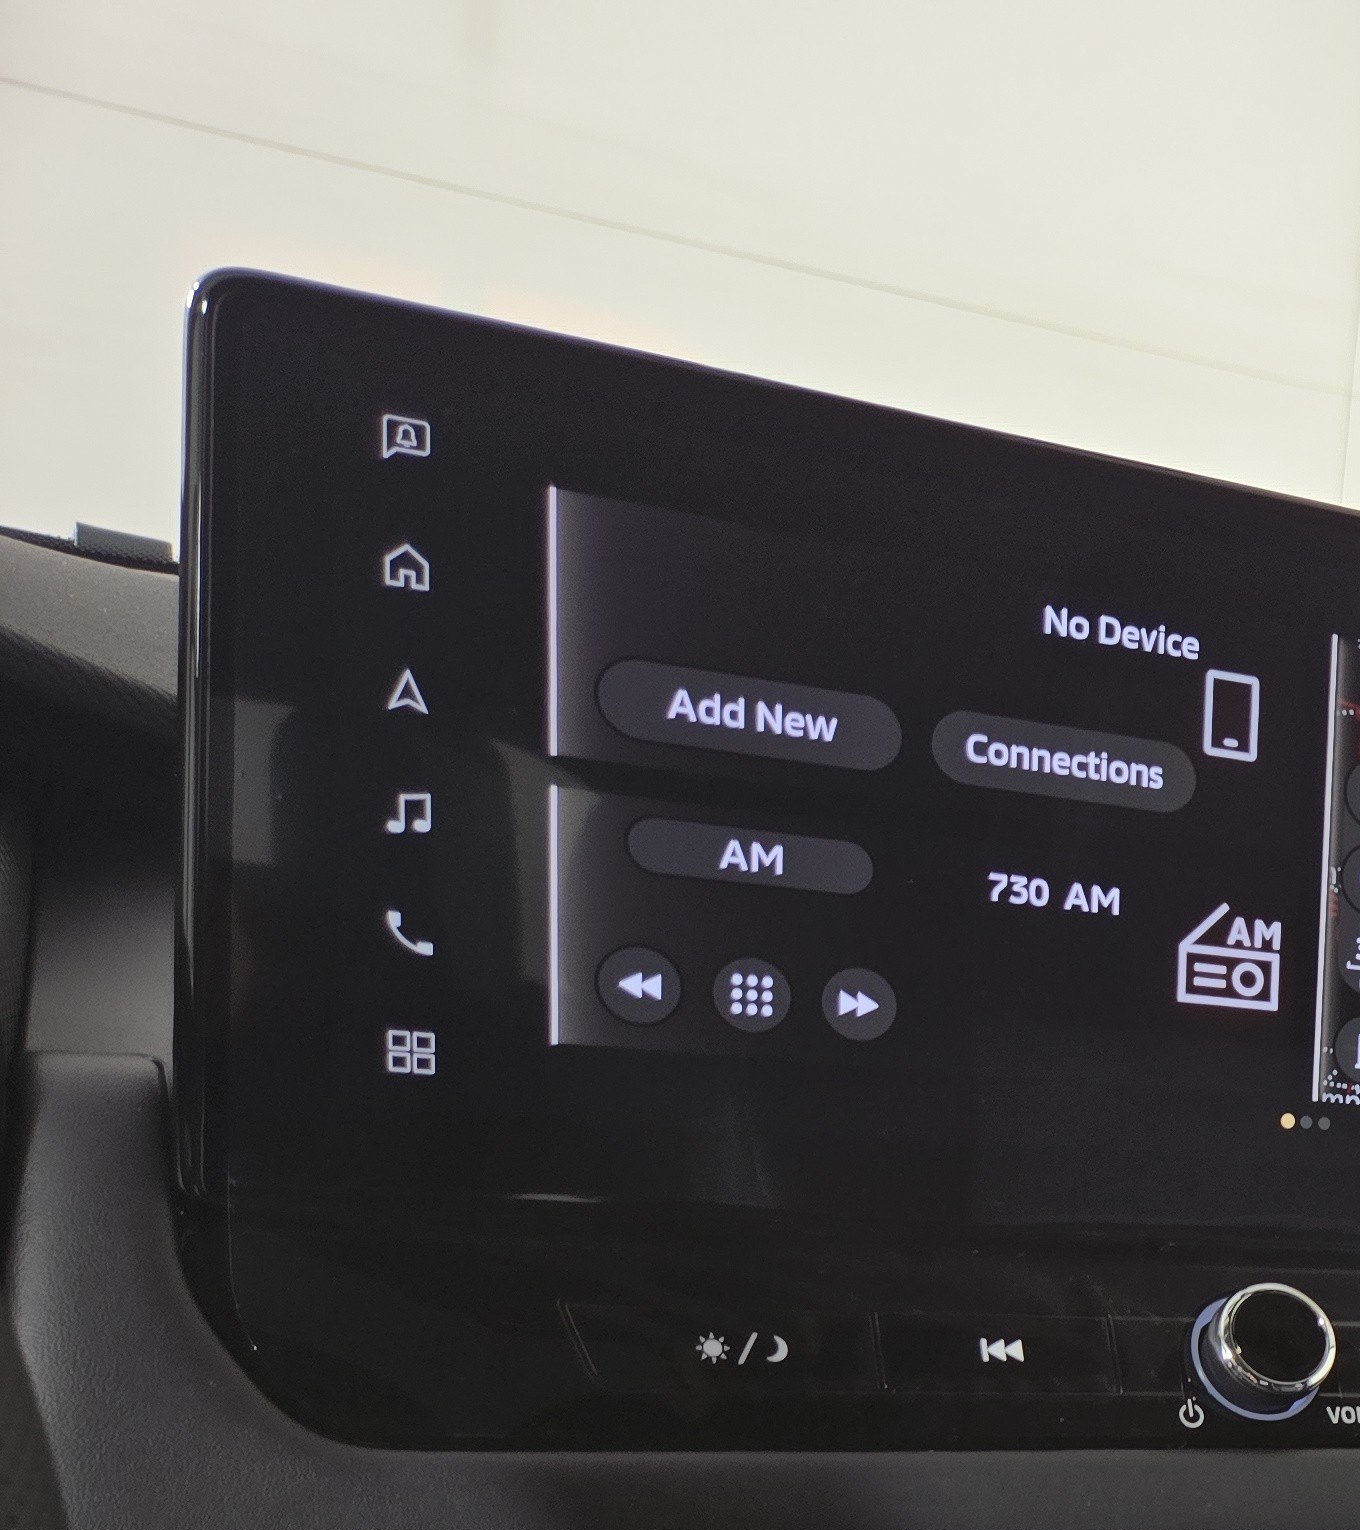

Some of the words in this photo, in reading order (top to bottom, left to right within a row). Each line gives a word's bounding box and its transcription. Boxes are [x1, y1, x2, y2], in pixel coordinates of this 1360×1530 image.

[1043, 605, 1091, 640] No
[1099, 614, 1201, 661] Device
[667, 688, 745, 730] Add
[755, 700, 838, 743] New
[965, 733, 1164, 790] Connections
[719, 838, 784, 876] AM
[987, 871, 1050, 908] 730
[1064, 881, 1122, 917] AM
[1226, 915, 1283, 951] AM
